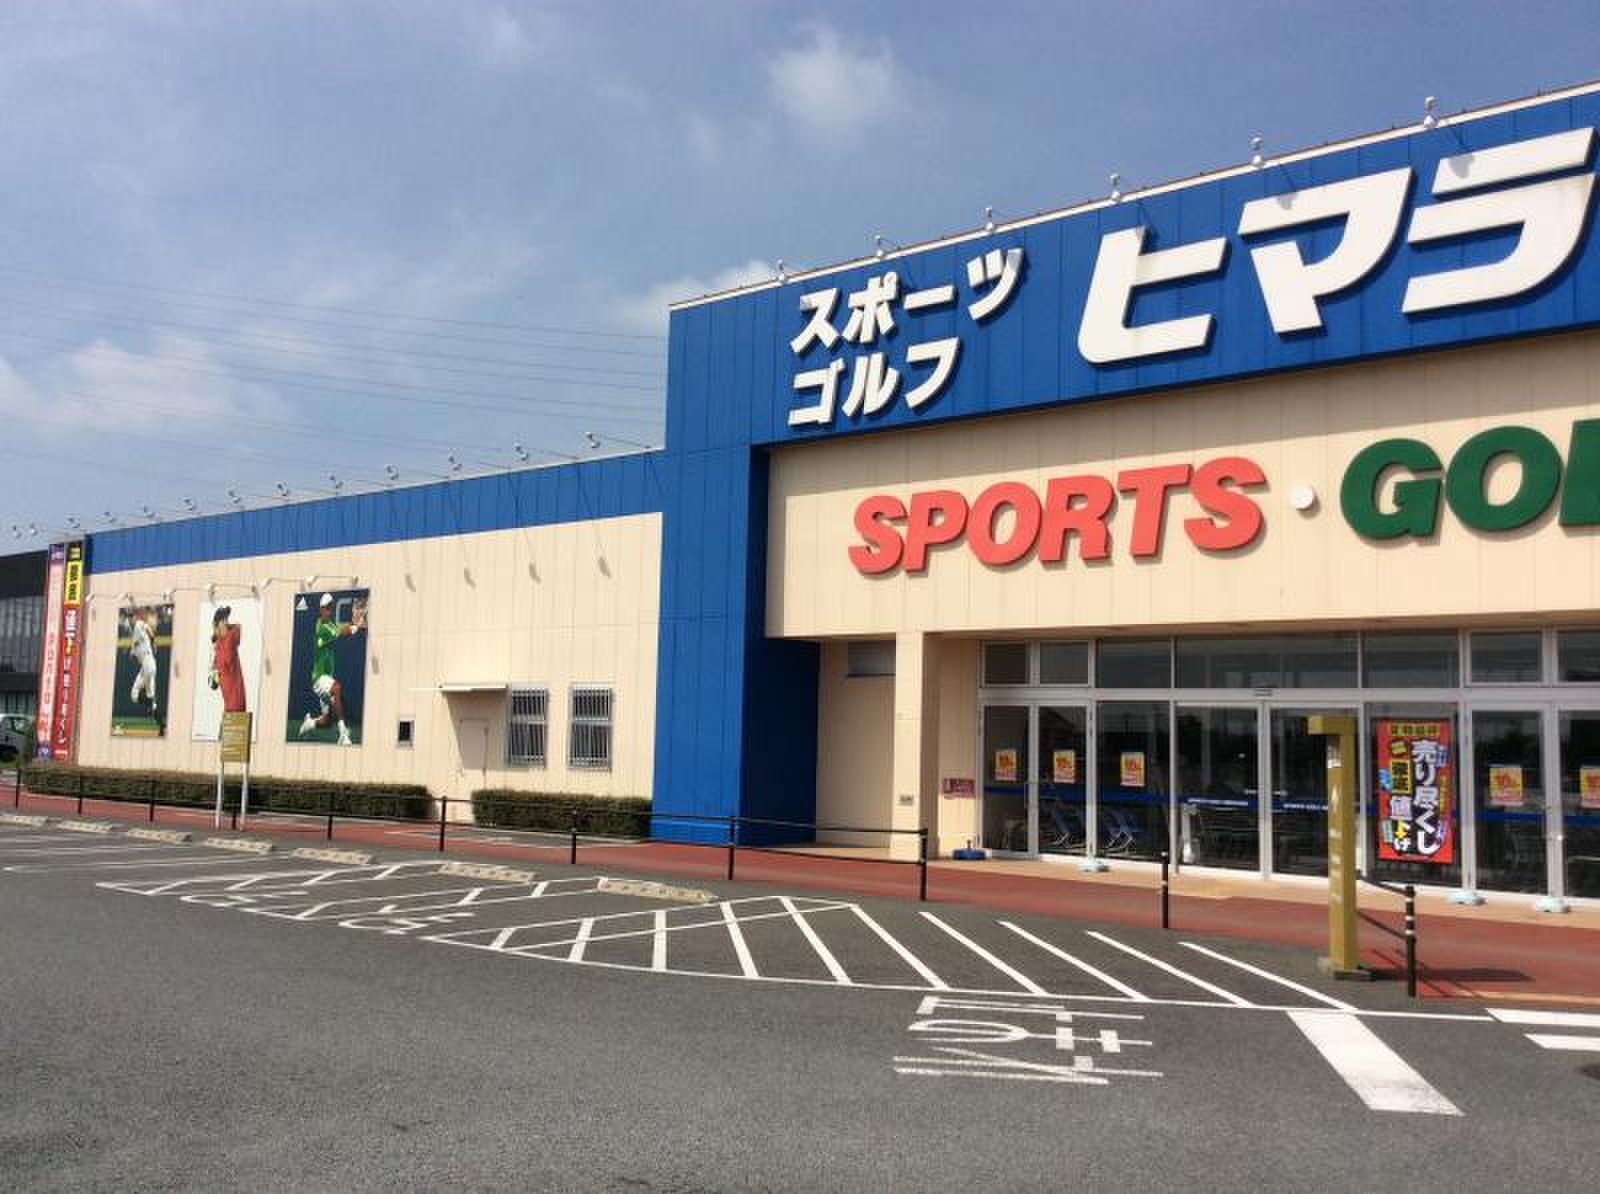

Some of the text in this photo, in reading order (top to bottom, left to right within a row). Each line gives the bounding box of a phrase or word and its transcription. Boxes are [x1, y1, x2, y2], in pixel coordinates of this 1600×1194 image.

[790, 248, 1024, 354] スポーツ
[1077, 127, 1597, 363] ヒマラ
[788, 336, 960, 425] ゴルフ
[848, 456, 1266, 574] SPORTS
[1411, 740, 1441, 855] 売り尽くし
